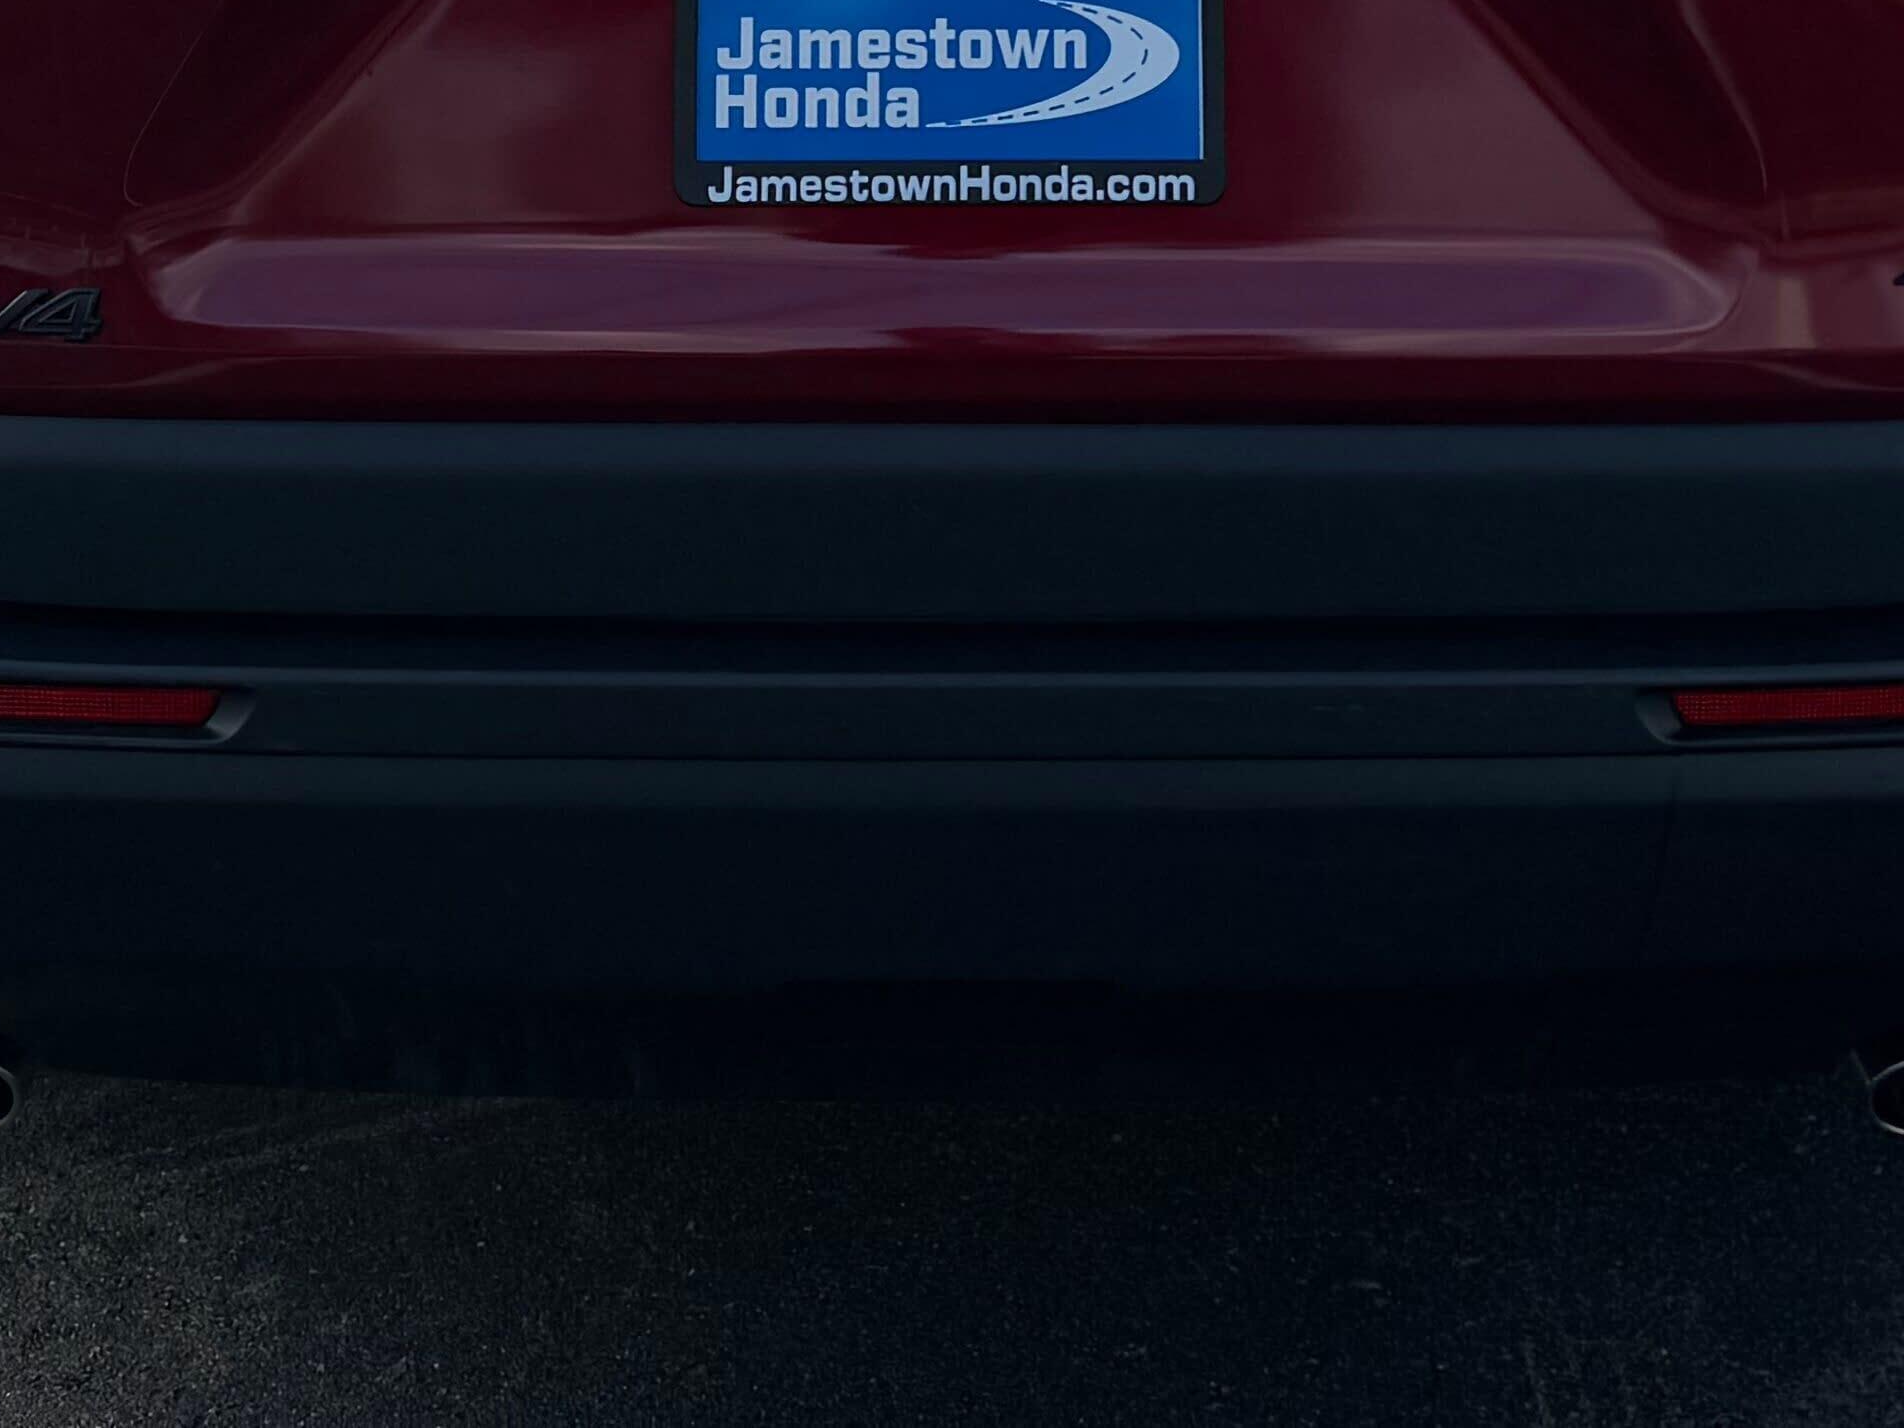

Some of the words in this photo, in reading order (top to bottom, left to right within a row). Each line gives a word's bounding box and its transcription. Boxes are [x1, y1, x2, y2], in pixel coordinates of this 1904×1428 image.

[716, 16, 1088, 70] Jamestown
[714, 71, 921, 129] Honda
[707, 164, 1196, 204] JamestownHonda.com
